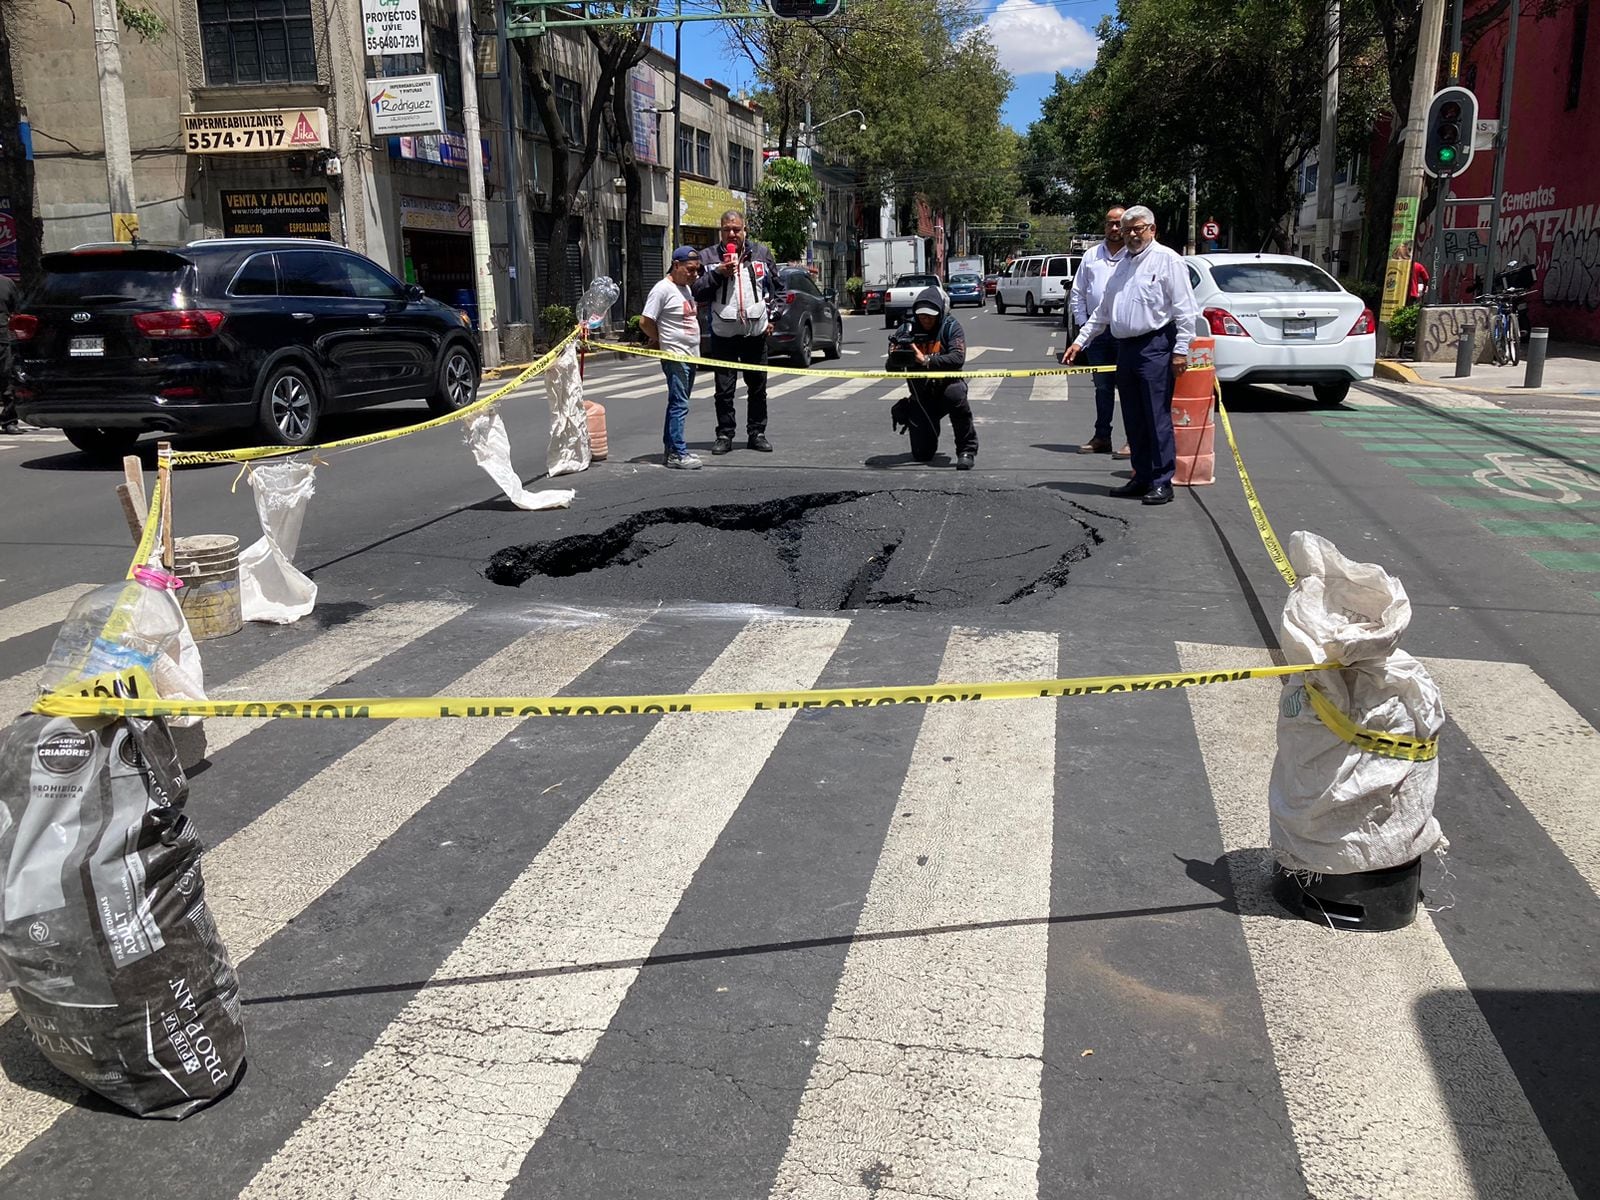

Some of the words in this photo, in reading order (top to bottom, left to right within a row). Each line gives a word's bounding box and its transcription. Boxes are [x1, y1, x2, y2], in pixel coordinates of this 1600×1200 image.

[365, 10, 417, 23] PROYECTOS
[185, 115, 284, 130] IMPERMEABILIZANTES
[294, 122, 314, 140] Sika
[226, 194, 257, 207] VENTA
[261, 193, 267, 206] Y
[271, 192, 328, 206] APLICACION
[1500, 185, 1556, 214] Cementos
[72, 312, 88, 321] KIA
[39, 748, 90, 757] CRIADORES
[33, 785, 84, 793] PROHIBIDA
[115, 912, 140, 955] ADULT
[165, 1013, 193, 1061] PURINA
